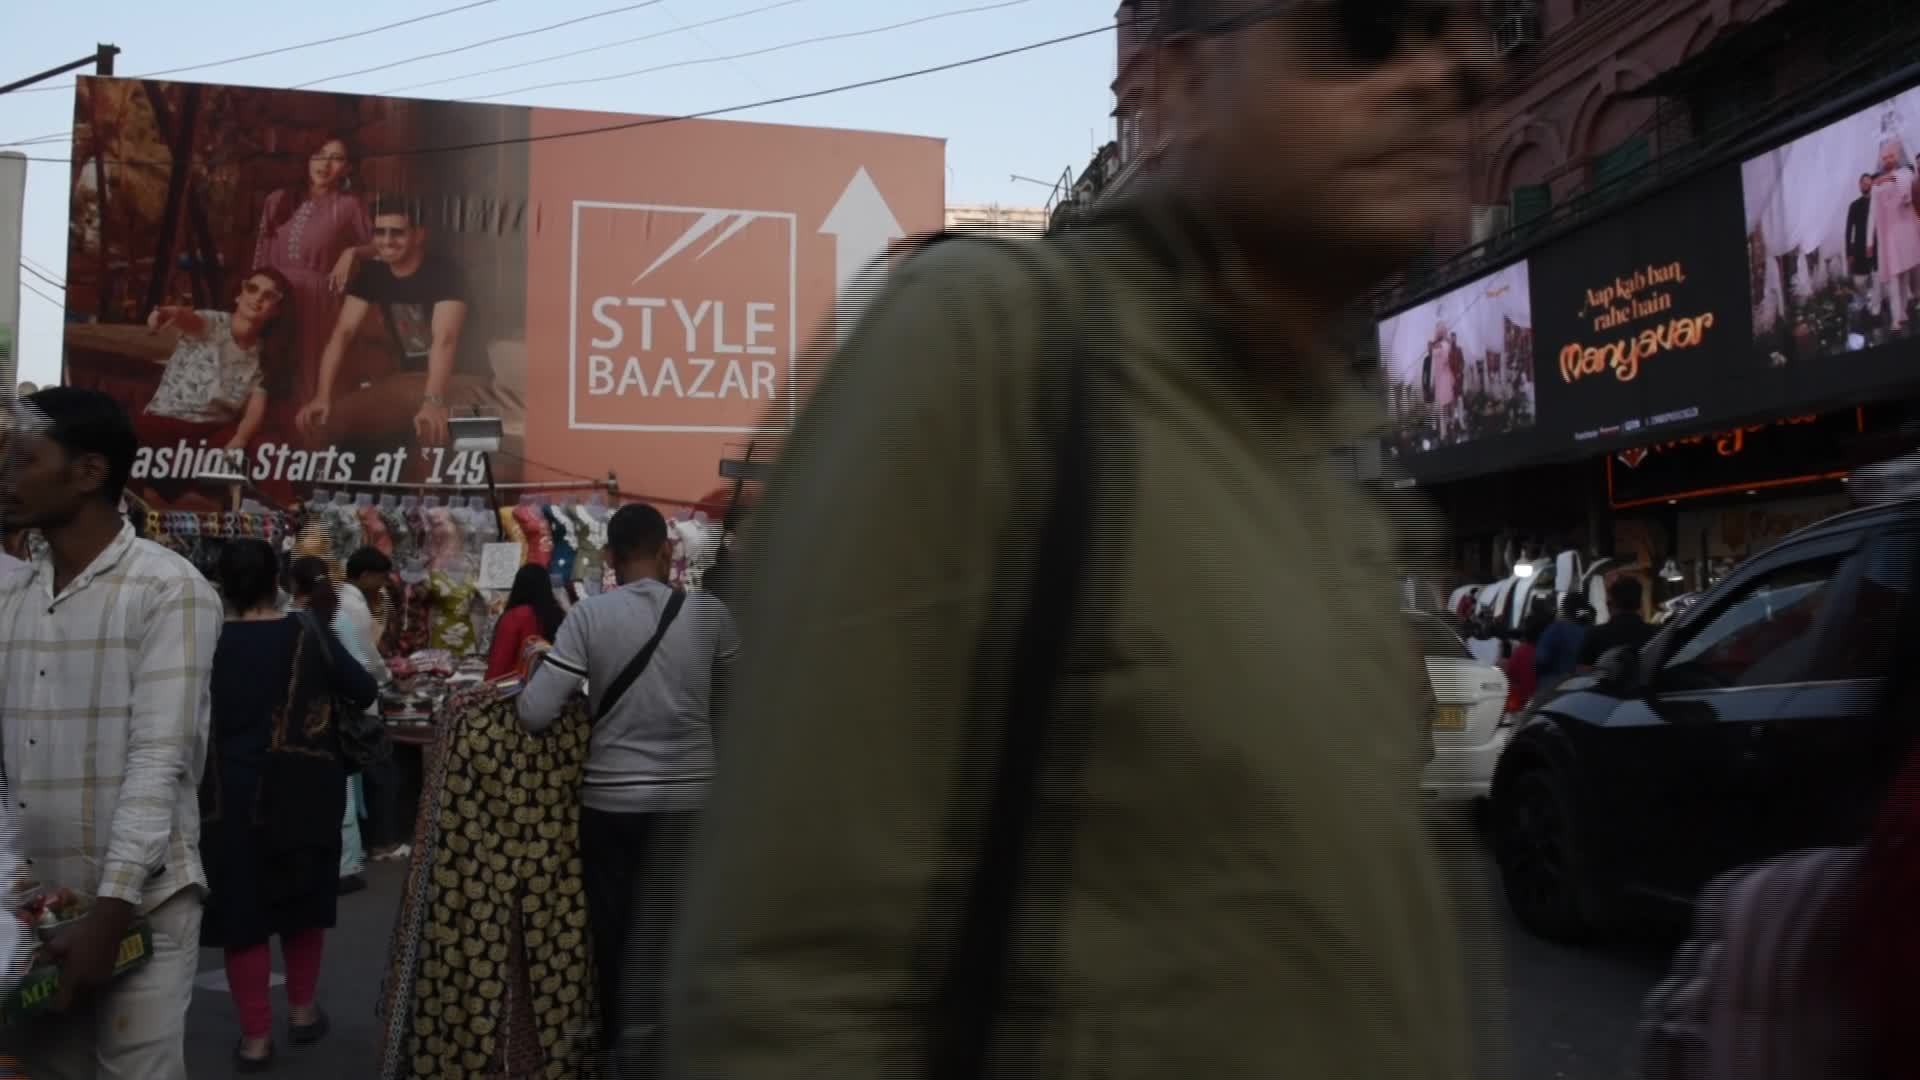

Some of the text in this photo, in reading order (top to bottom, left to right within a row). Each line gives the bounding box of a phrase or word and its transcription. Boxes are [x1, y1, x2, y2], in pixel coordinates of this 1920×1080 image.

[1577, 260, 1687, 319] Aap kab ban
[1593, 291, 1672, 333] rahe hain
[591, 295, 777, 355] STYLE
[1559, 311, 1715, 384] Manyavar
[588, 354, 777, 400] BAAZAR
[130, 438, 245, 480] ashion
[252, 442, 357, 482] Starts
[371, 446, 406, 482] at
